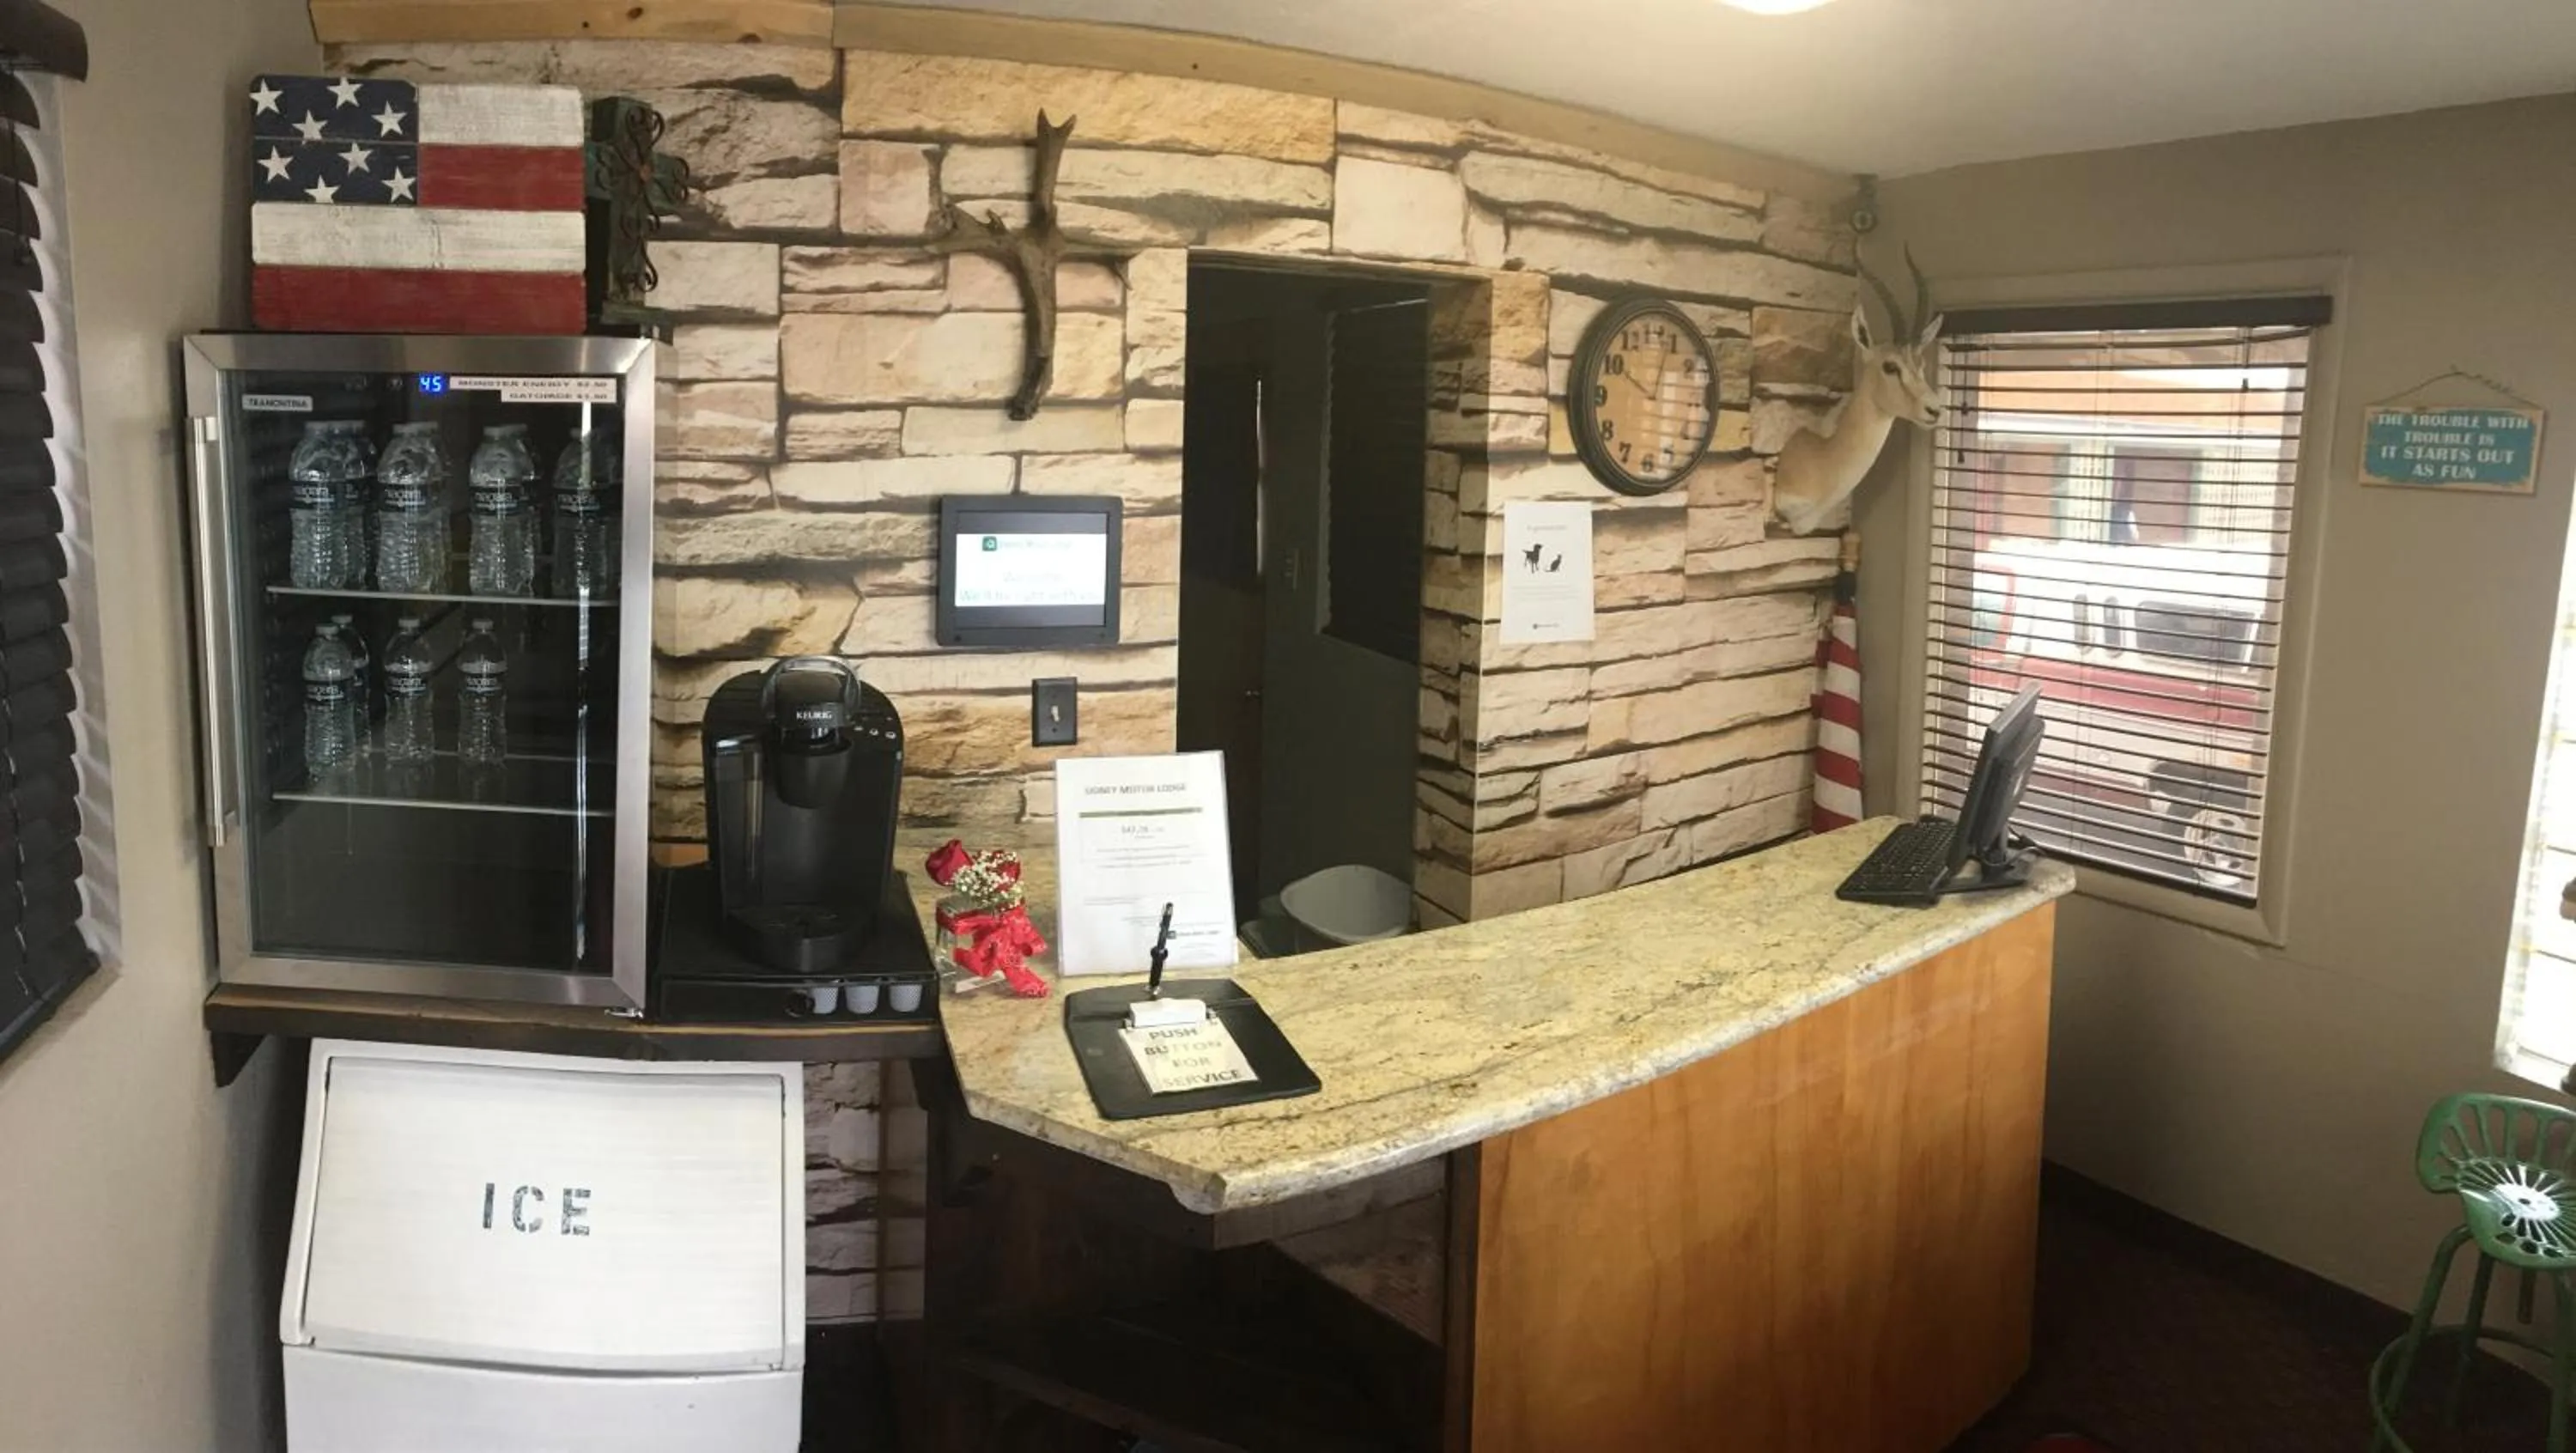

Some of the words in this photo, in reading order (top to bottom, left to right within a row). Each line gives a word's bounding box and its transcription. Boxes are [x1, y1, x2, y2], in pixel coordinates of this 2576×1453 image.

[1604, 354, 1624, 375] 10
[421, 375, 441, 392] 45
[248, 398, 308, 408] TRAMONTINA
[2378, 413, 2403, 426] THE
[2411, 414, 2481, 429] TROUBLE
[2487, 416, 2529, 429] WITH
[1601, 420, 1613, 441] 8
[2403, 430, 2475, 445] TROUBLE
[2478, 432, 2494, 446] IS
[1619, 441, 1631, 464] 7
[2380, 445, 2397, 459] IT
[2403, 445, 2471, 463] STARTS
[2477, 449, 2515, 465] OUT
[1641, 453, 1655, 473] 6
[2412, 463, 2434, 477] AS
[2440, 465, 2477, 479] FUN
[796, 710, 832, 720] KEURIG
[1120, 784, 1155, 794] MOTOR
[1157, 782, 1186, 793] LODGE
[1149, 1027, 1198, 1040] PUSH
[1144, 1040, 1223, 1055] BUTTON
[1172, 1056, 1212, 1068] FOR
[1163, 1069, 1242, 1088] SERVICE
[482, 1182, 592, 1237] ICE
